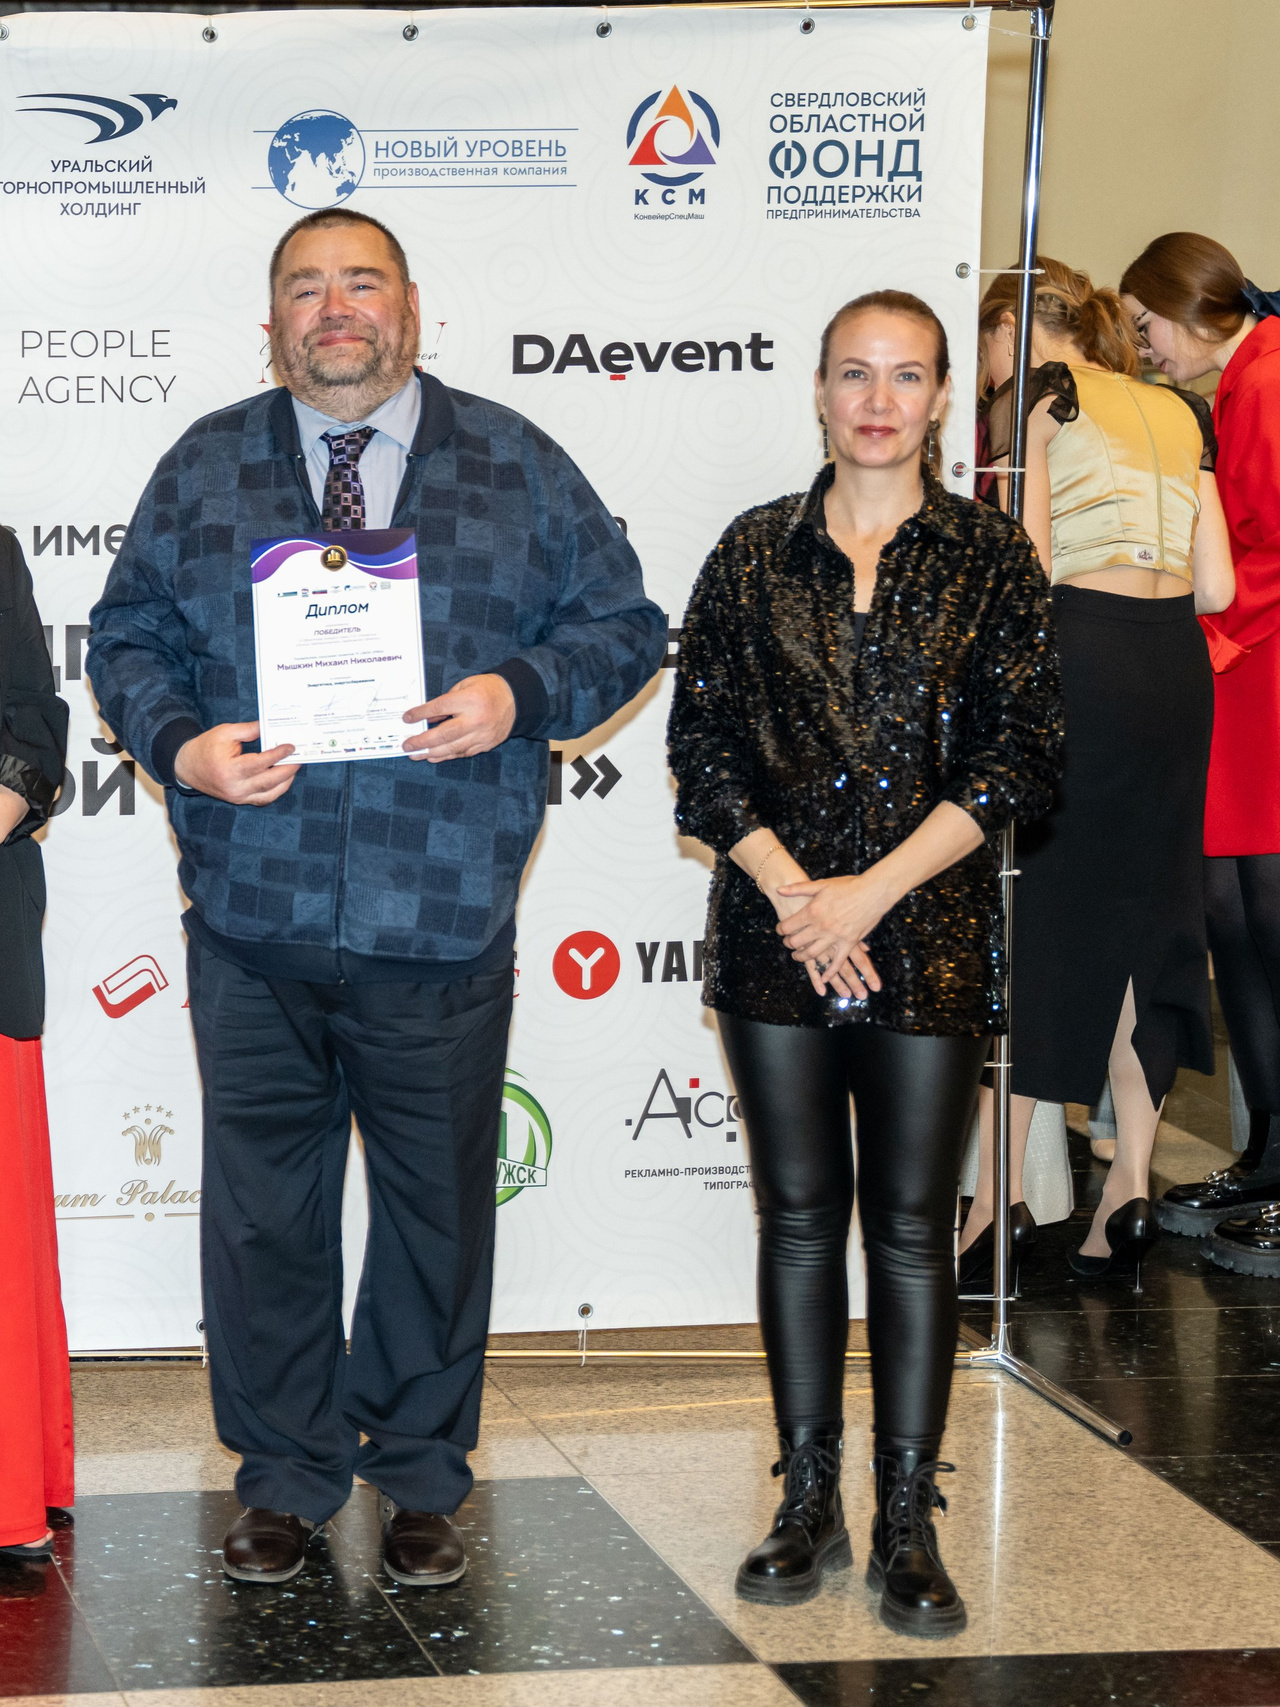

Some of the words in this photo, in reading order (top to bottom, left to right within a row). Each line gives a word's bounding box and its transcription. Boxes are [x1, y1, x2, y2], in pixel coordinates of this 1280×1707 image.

[769, 88, 927, 109] СВЕРДЛОВСКИЙ
[769, 109, 925, 133] ОБЛАСТНОЙ
[374, 136, 458, 159] НОВЫЙ
[465, 139, 567, 158] УРОВЕНЬ
[51, 155, 153, 173] УРАЛЬСКИЙ
[768, 139, 922, 182] ФОНД
[373, 164, 498, 178] производственная
[503, 164, 568, 176] компания
[767, 184, 922, 206] ПОДДЕРЖКИ
[60, 202, 142, 218] ХОЛДИНГ
[634, 212, 705, 221] КонвейерСпецМаш
[766, 207, 921, 220] ПРЕДПРИНИМАТЕЛЬСТВА
[21, 329, 171, 358] PEOPLE
[512, 332, 774, 377] DAevent
[18, 375, 176, 404] AGENCY
[305, 603, 369, 619] Диплом
[314, 627, 361, 636] ПОБЕДИТЕЛЬ
[277, 662, 313, 671] Мышкин
[315, 658, 349, 668] Михаил
[350, 654, 403, 665] Николаевич
[624, 1165, 752, 1179] РЕКЛАМНО-ПРОИЗВОДСТ
[116, 1178, 201, 1206] Palac
[703, 1180, 754, 1190] ТИПОГРА
